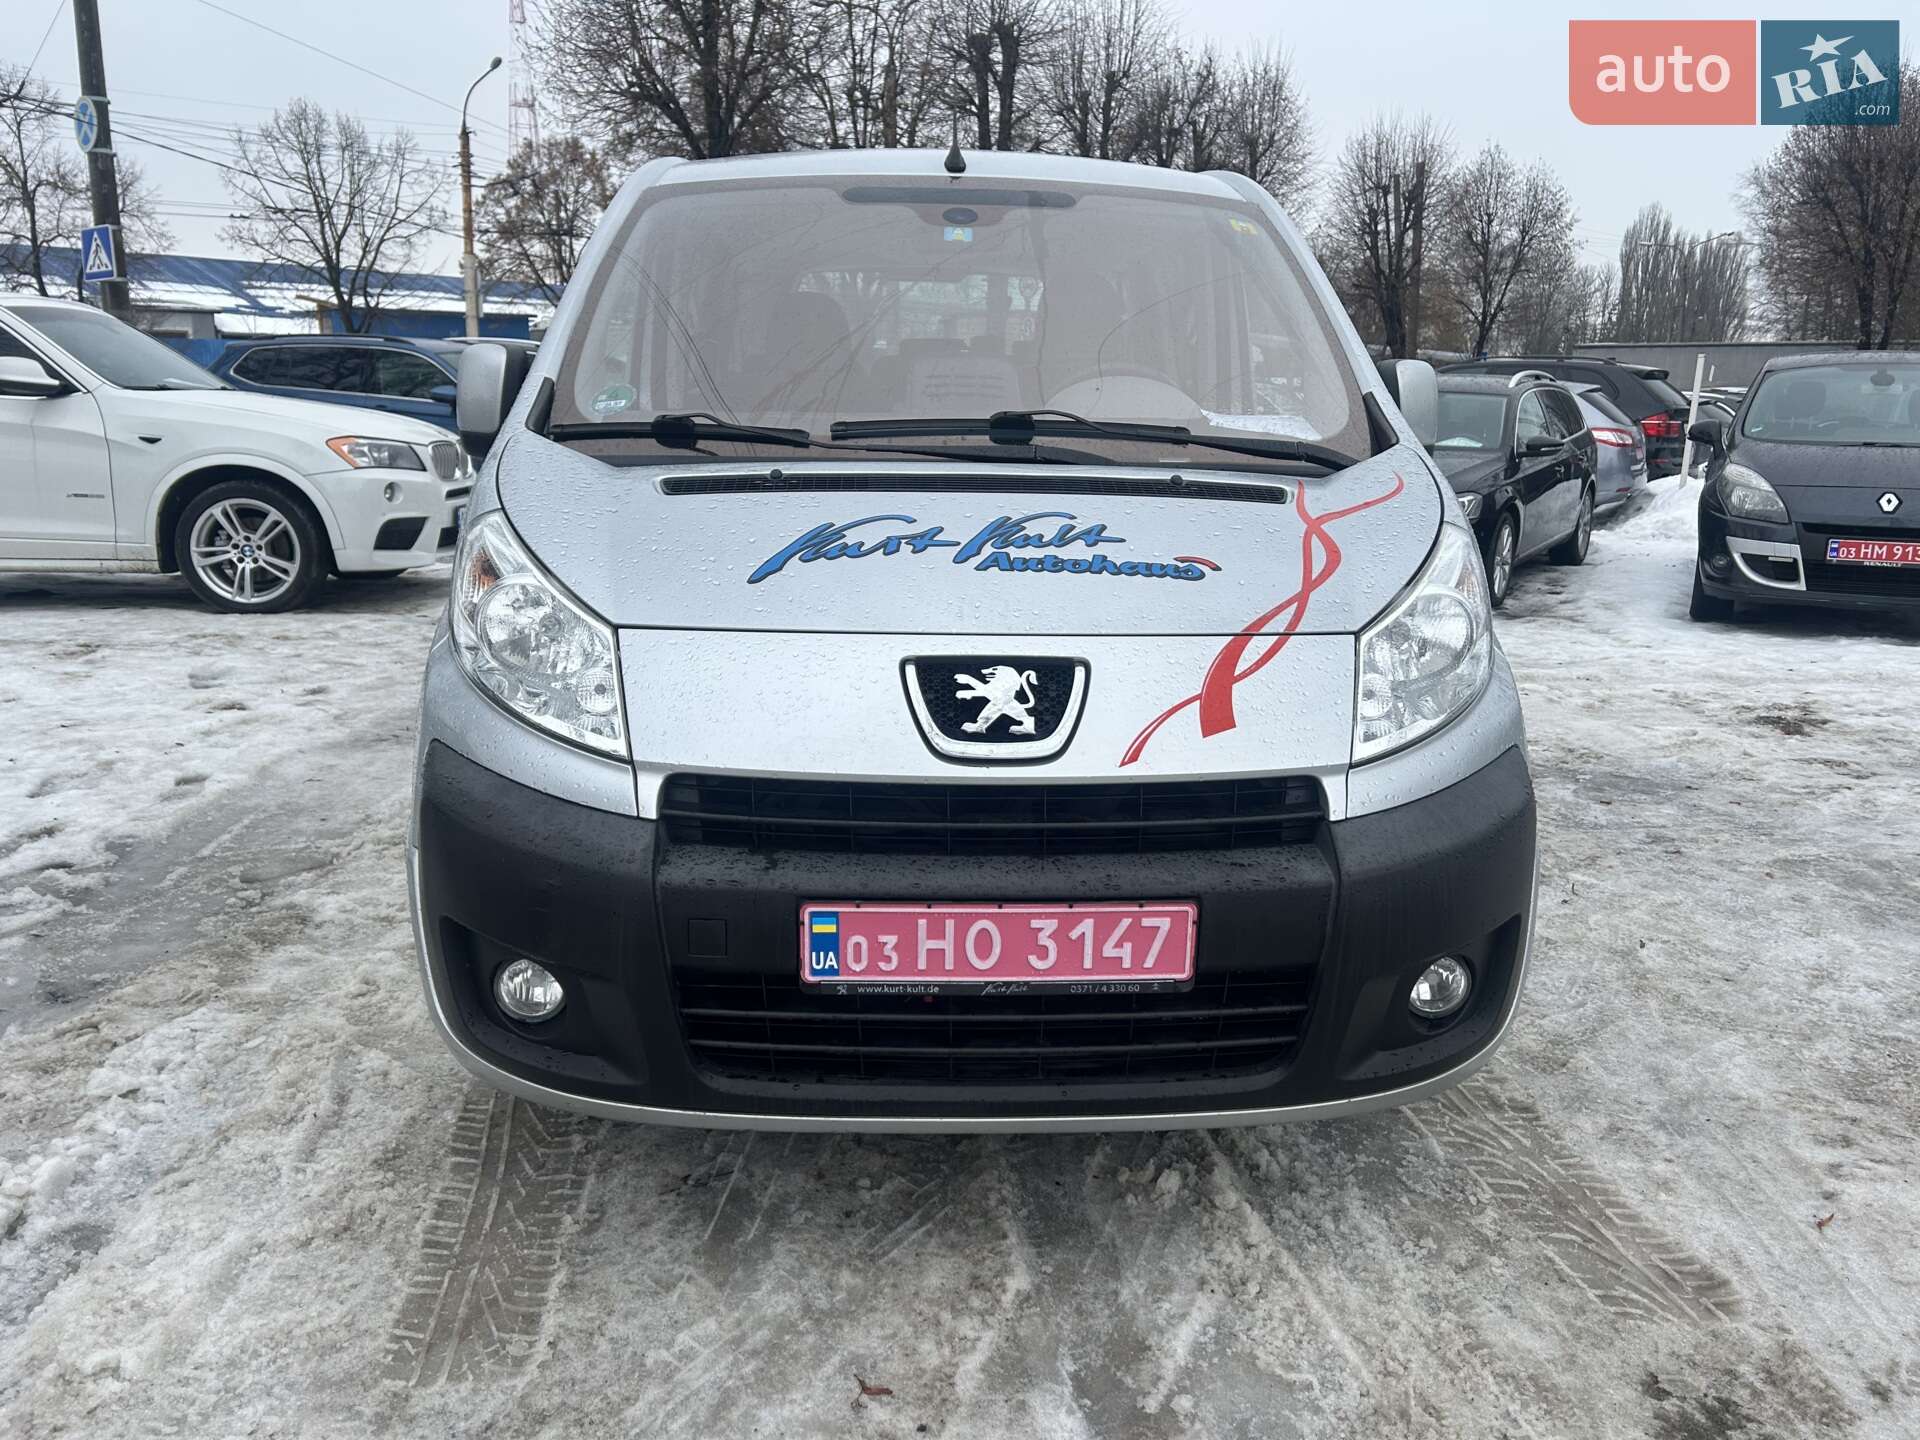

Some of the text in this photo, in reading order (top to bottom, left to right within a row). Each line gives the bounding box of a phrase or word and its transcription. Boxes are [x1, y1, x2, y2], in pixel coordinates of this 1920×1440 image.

[746, 514, 961, 585] Kurt
[1840, 547, 1856, 559] 03
[1860, 543, 1888, 560] HM
[973, 551, 1207, 582] Autohaus
[846, 917, 1172, 972] 03 HO 3147
[811, 951, 838, 970] UA
[857, 984, 940, 994] www.kurt-kult.de
[1070, 984, 1092, 993] 0371
